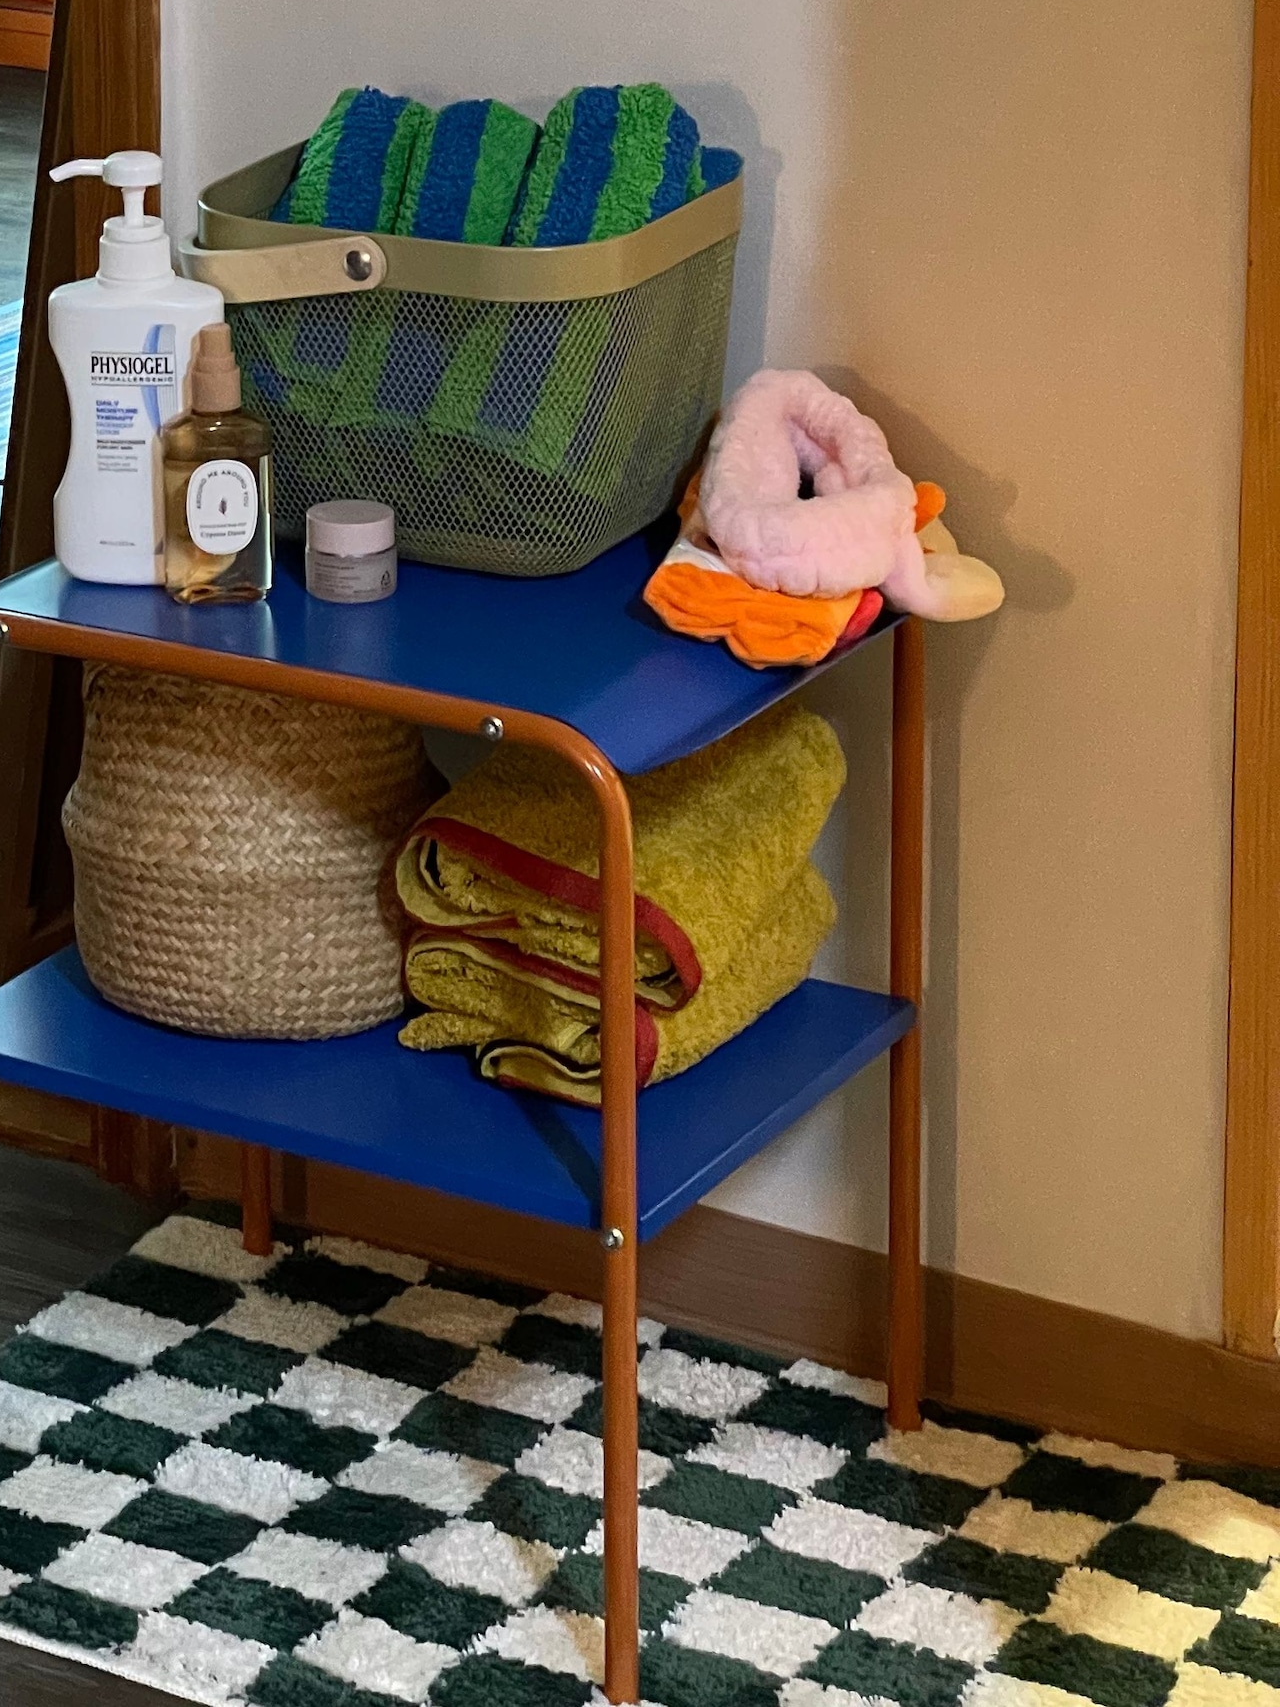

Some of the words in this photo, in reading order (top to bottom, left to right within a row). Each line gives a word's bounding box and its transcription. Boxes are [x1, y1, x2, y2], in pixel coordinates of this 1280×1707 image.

[91, 356, 173, 375] PHYSIOGEL
[207, 470, 218, 478] ME
[221, 469, 247, 490] AROUND
